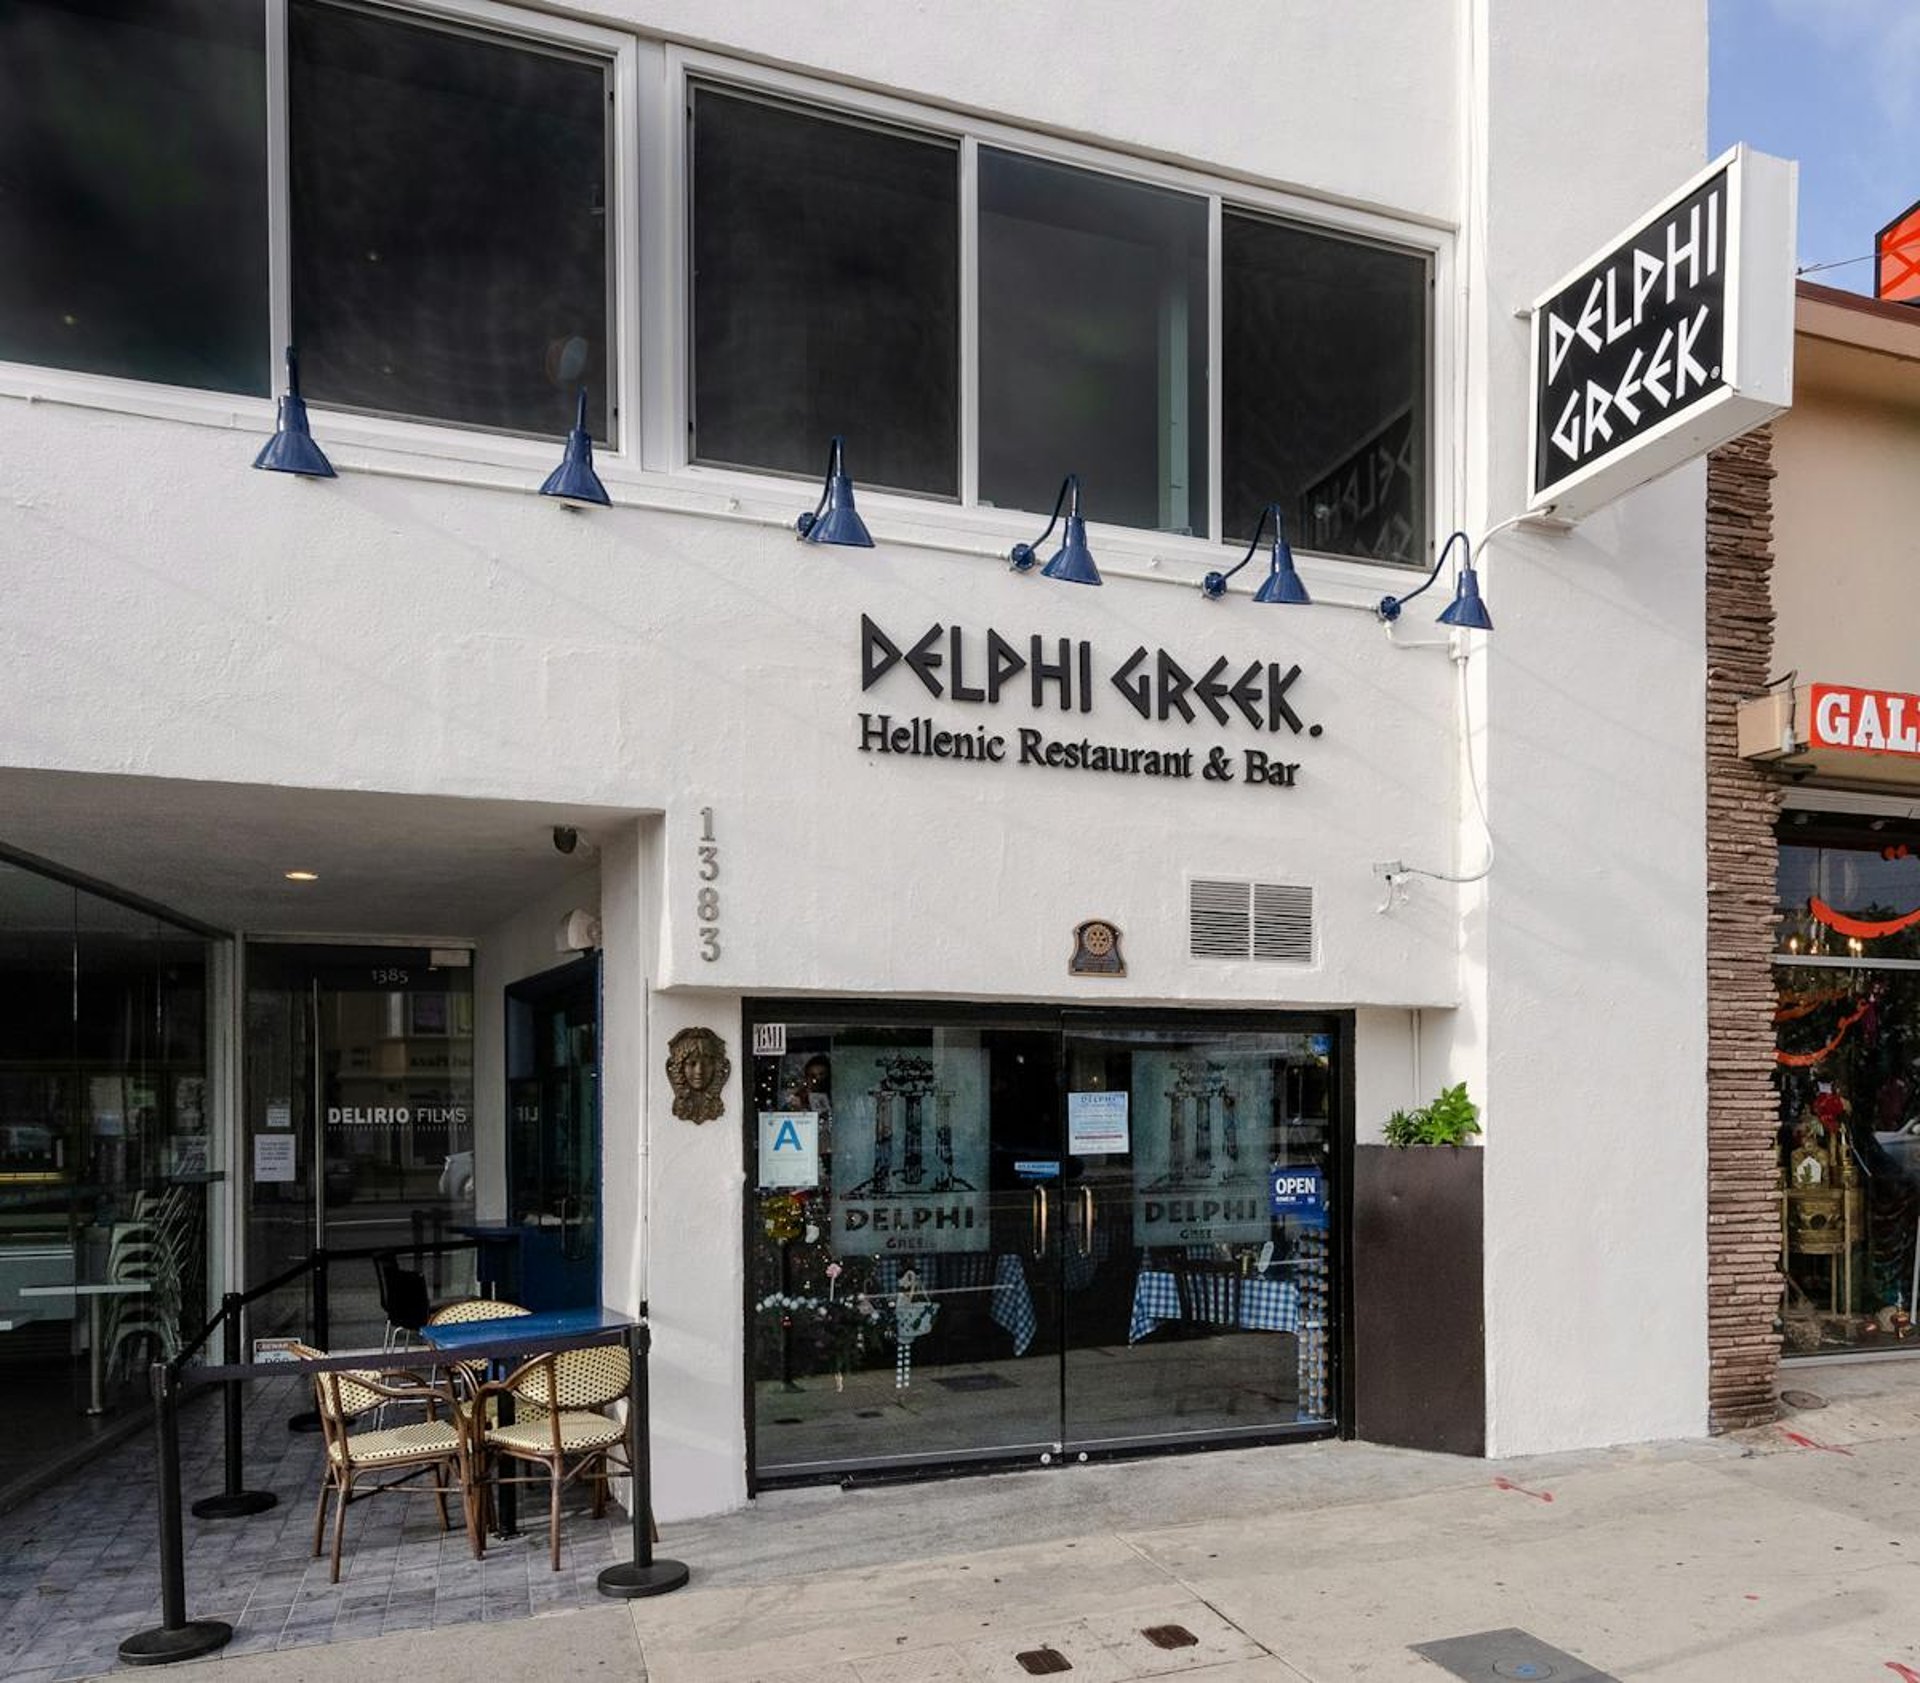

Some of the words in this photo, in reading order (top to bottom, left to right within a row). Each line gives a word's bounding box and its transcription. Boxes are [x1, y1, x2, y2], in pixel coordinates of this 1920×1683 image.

[1549, 191, 1718, 387] DELPHI
[861, 612, 1091, 713] DELPHI
[1816, 692, 1920, 753] GAL
[857, 712, 1006, 762] Hellenic
[1018, 727, 1192, 779] Restaurant
[1202, 745, 1234, 783] &
[1243, 749, 1301, 788] Bar
[697, 806, 721, 963] 1383
[371, 968, 409, 984] 1385
[328, 1107, 410, 1124] DELIRIO
[416, 1107, 467, 1123] FILMS
[773, 1119, 803, 1151] A
[1275, 1177, 1316, 1195] OPEN
[845, 1206, 974, 1231] DELPHI
[1145, 1200, 1257, 1223] DELPHI
